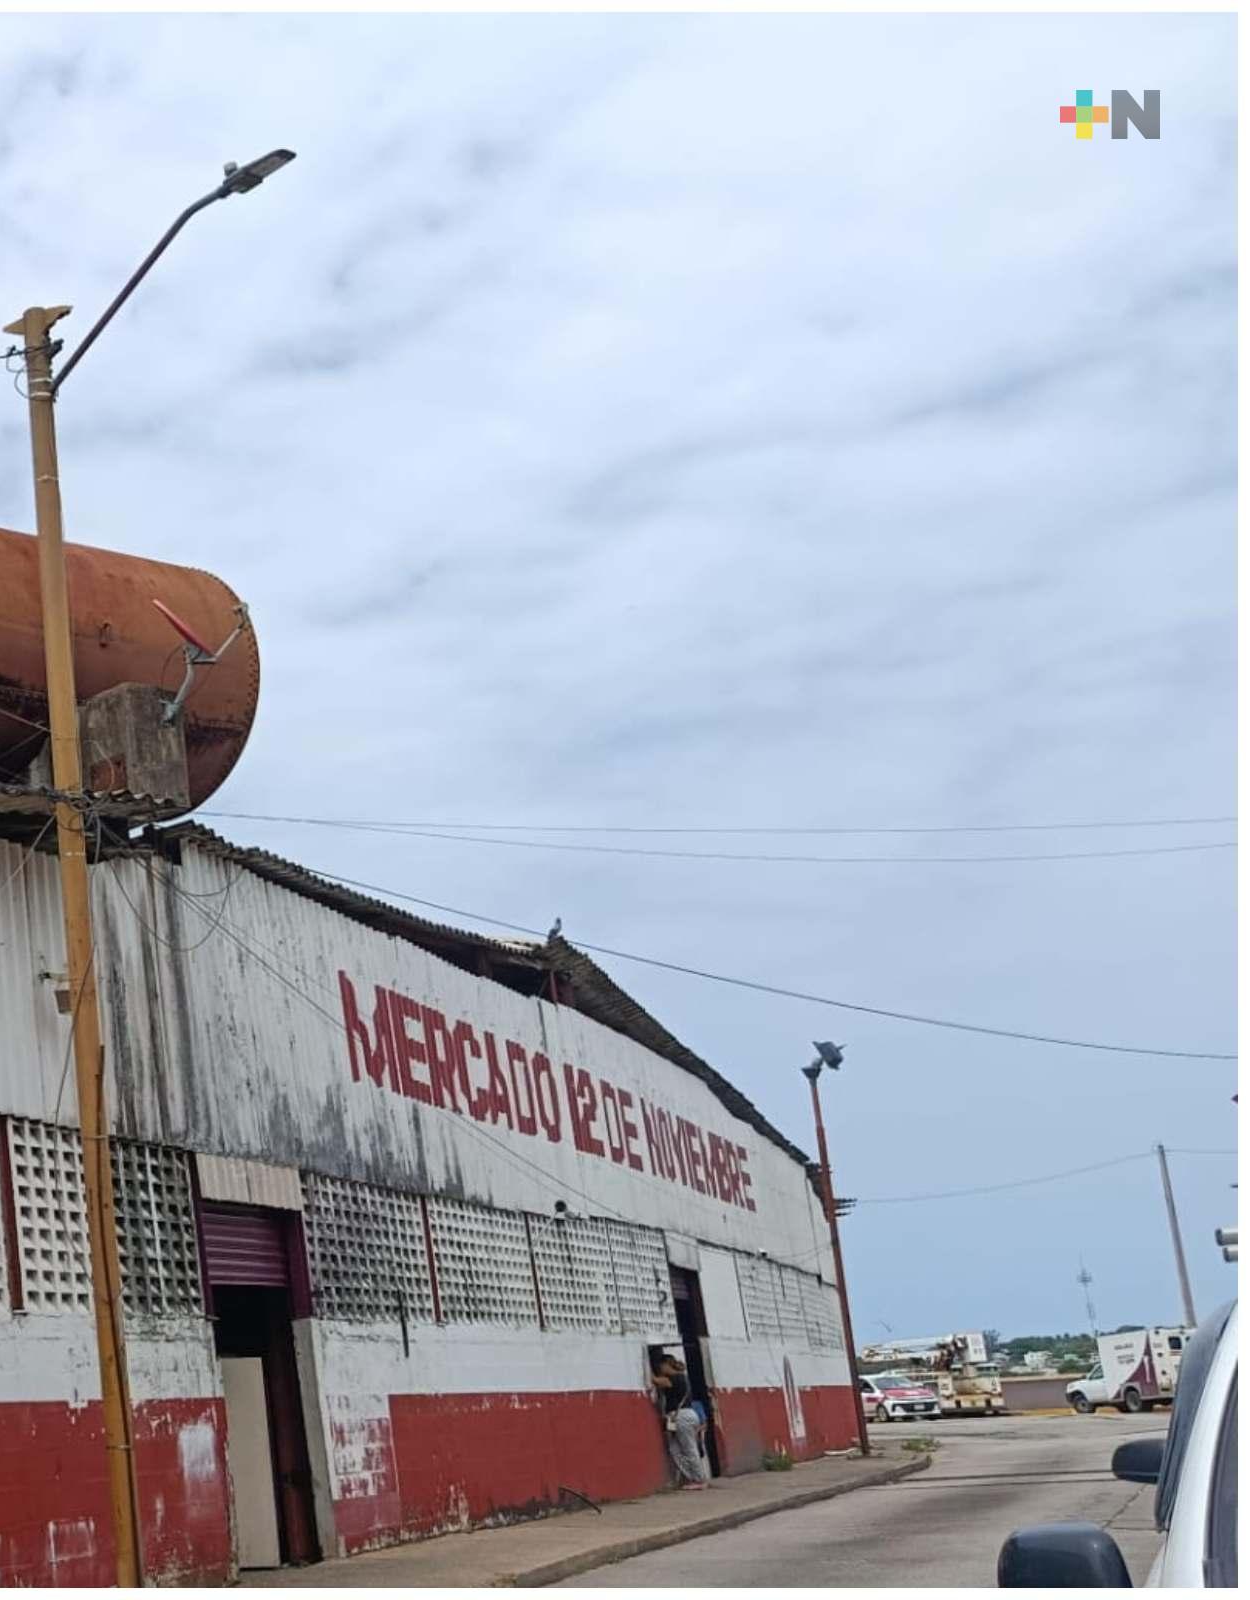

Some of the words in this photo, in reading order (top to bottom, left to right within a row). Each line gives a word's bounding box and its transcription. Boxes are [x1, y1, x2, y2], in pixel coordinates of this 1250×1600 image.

[338, 969, 562, 1143] MERCADO
[564, 1063, 605, 1157] 12
[601, 1080, 644, 1172] DE
[640, 1099, 756, 1211] NOVIEMBRE
